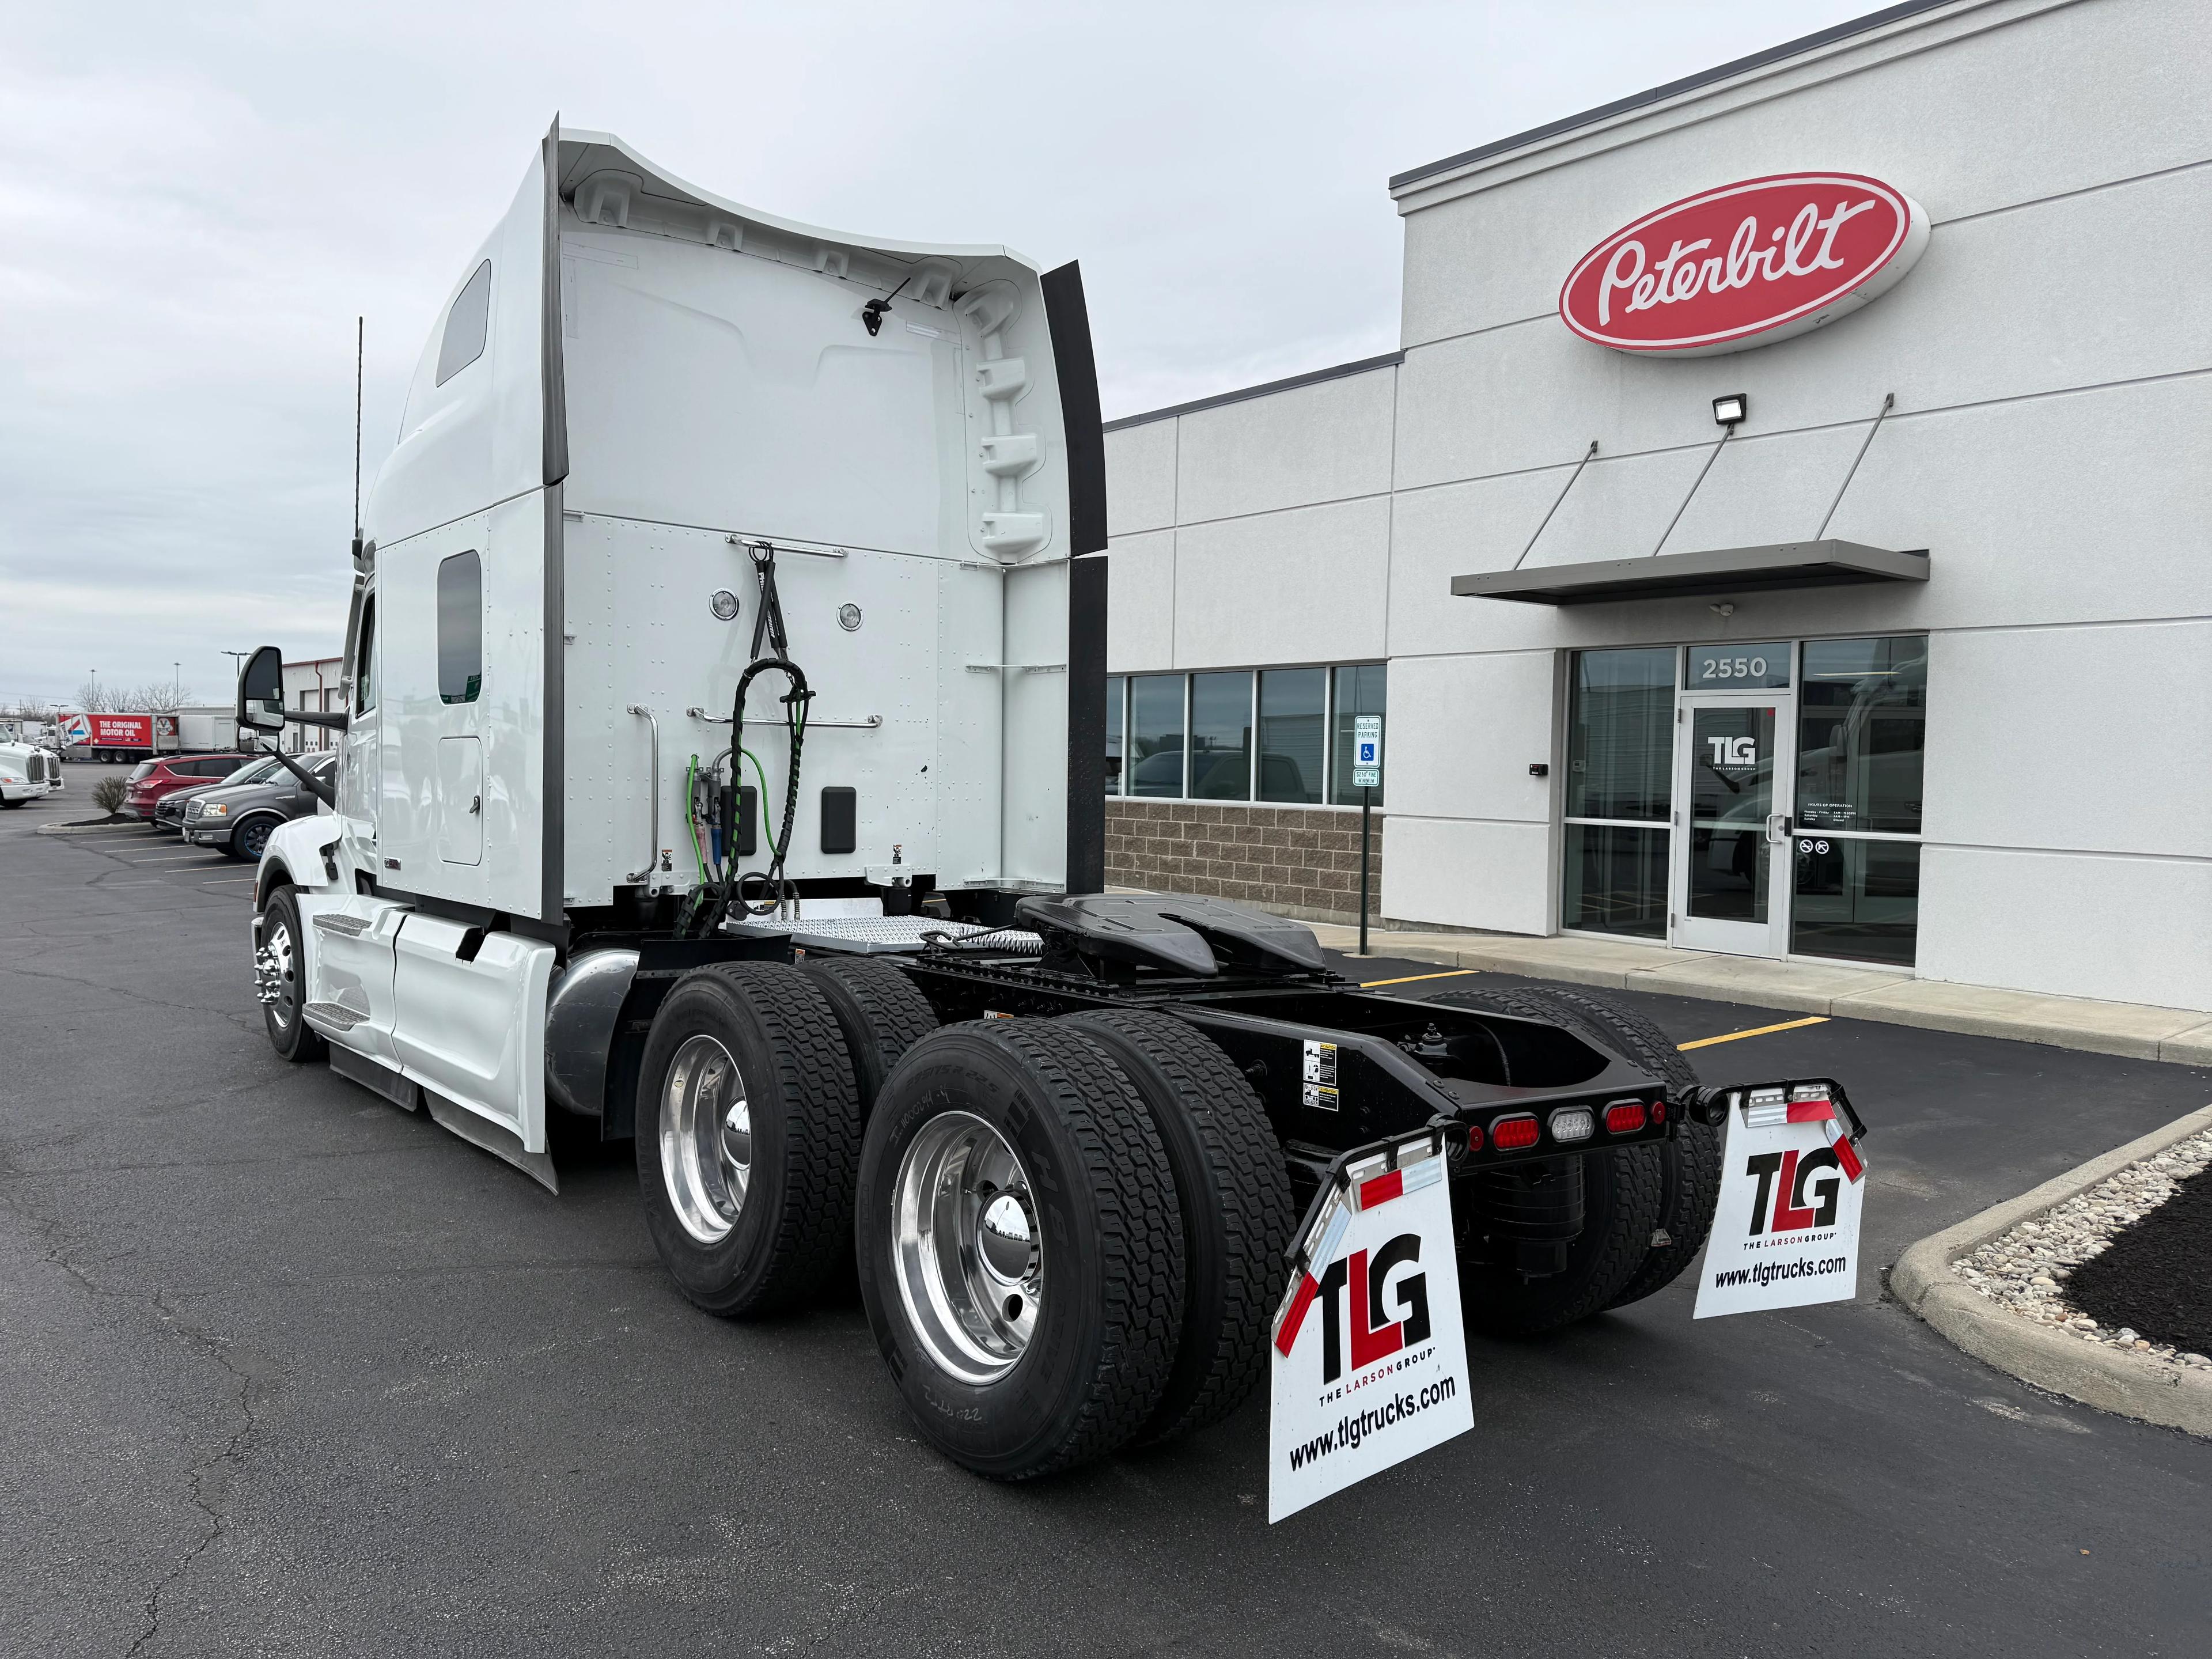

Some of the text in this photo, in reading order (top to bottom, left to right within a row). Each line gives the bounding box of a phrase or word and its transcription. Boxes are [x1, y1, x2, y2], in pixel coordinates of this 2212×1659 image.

[1599, 199, 1876, 327] Peterbilt
[1702, 657, 1767, 679] 2550
[1707, 737, 1755, 764] TLG
[1746, 1147, 1841, 1236] TLG
[1744, 1241, 1761, 1251] THE
[1715, 1256, 1846, 1289] www.tlgtrucks.com
[1313, 1233, 1431, 1385] TLG
[1319, 1389, 1343, 1408] THE
[1289, 1374, 1456, 1472] www.tlgtrucks.com
